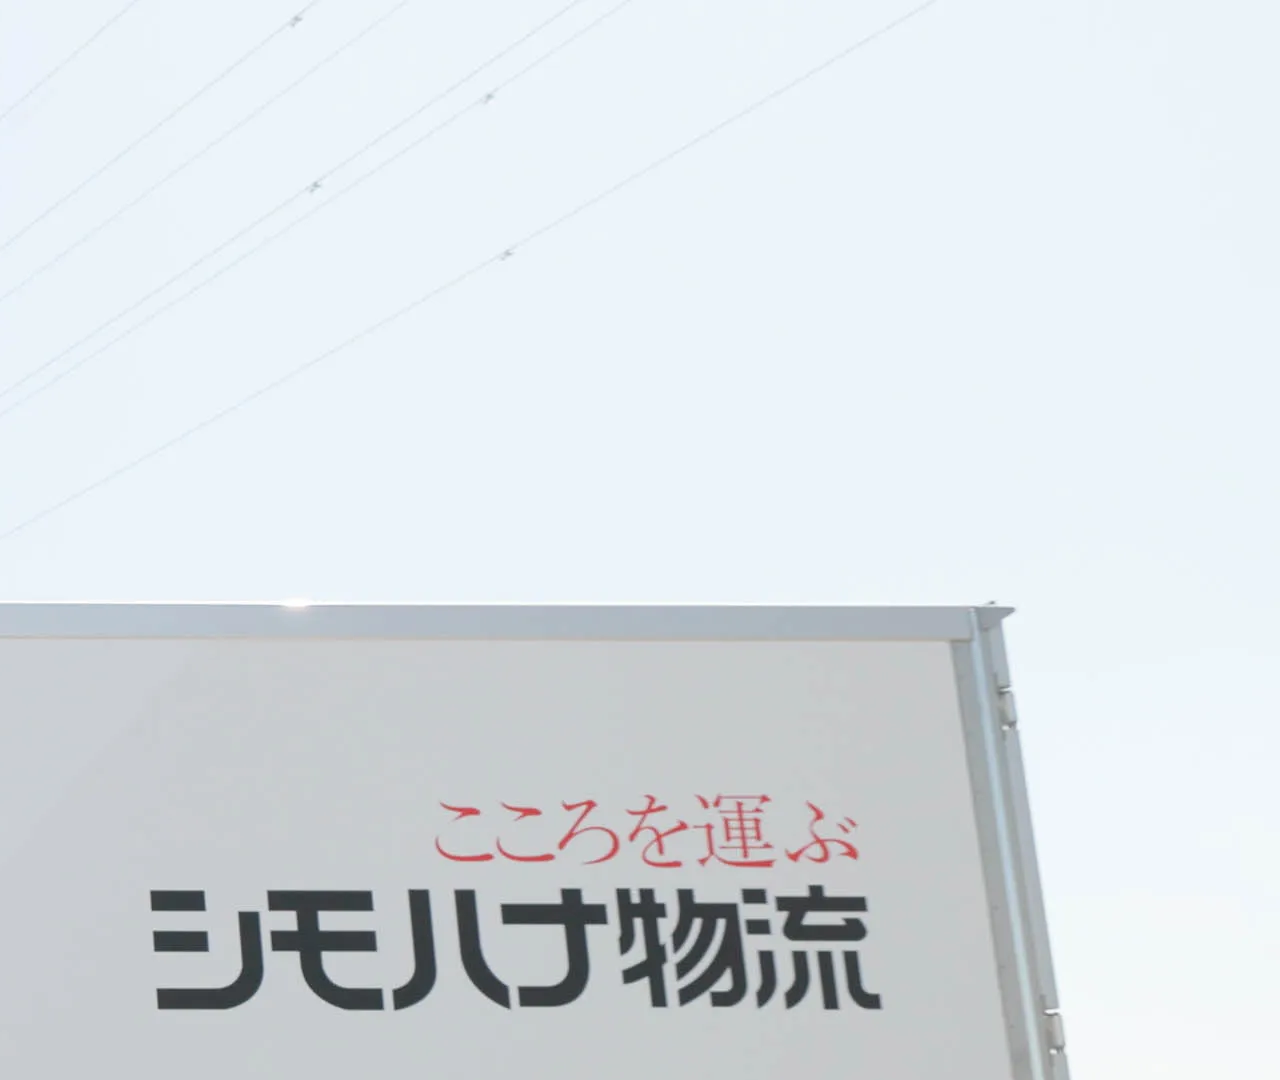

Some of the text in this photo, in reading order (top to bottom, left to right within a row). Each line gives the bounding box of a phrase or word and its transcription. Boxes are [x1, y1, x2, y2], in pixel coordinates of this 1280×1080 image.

[434, 794, 860, 869] こころを運ぶ
[150, 884, 883, 1011] シモハナ物流
